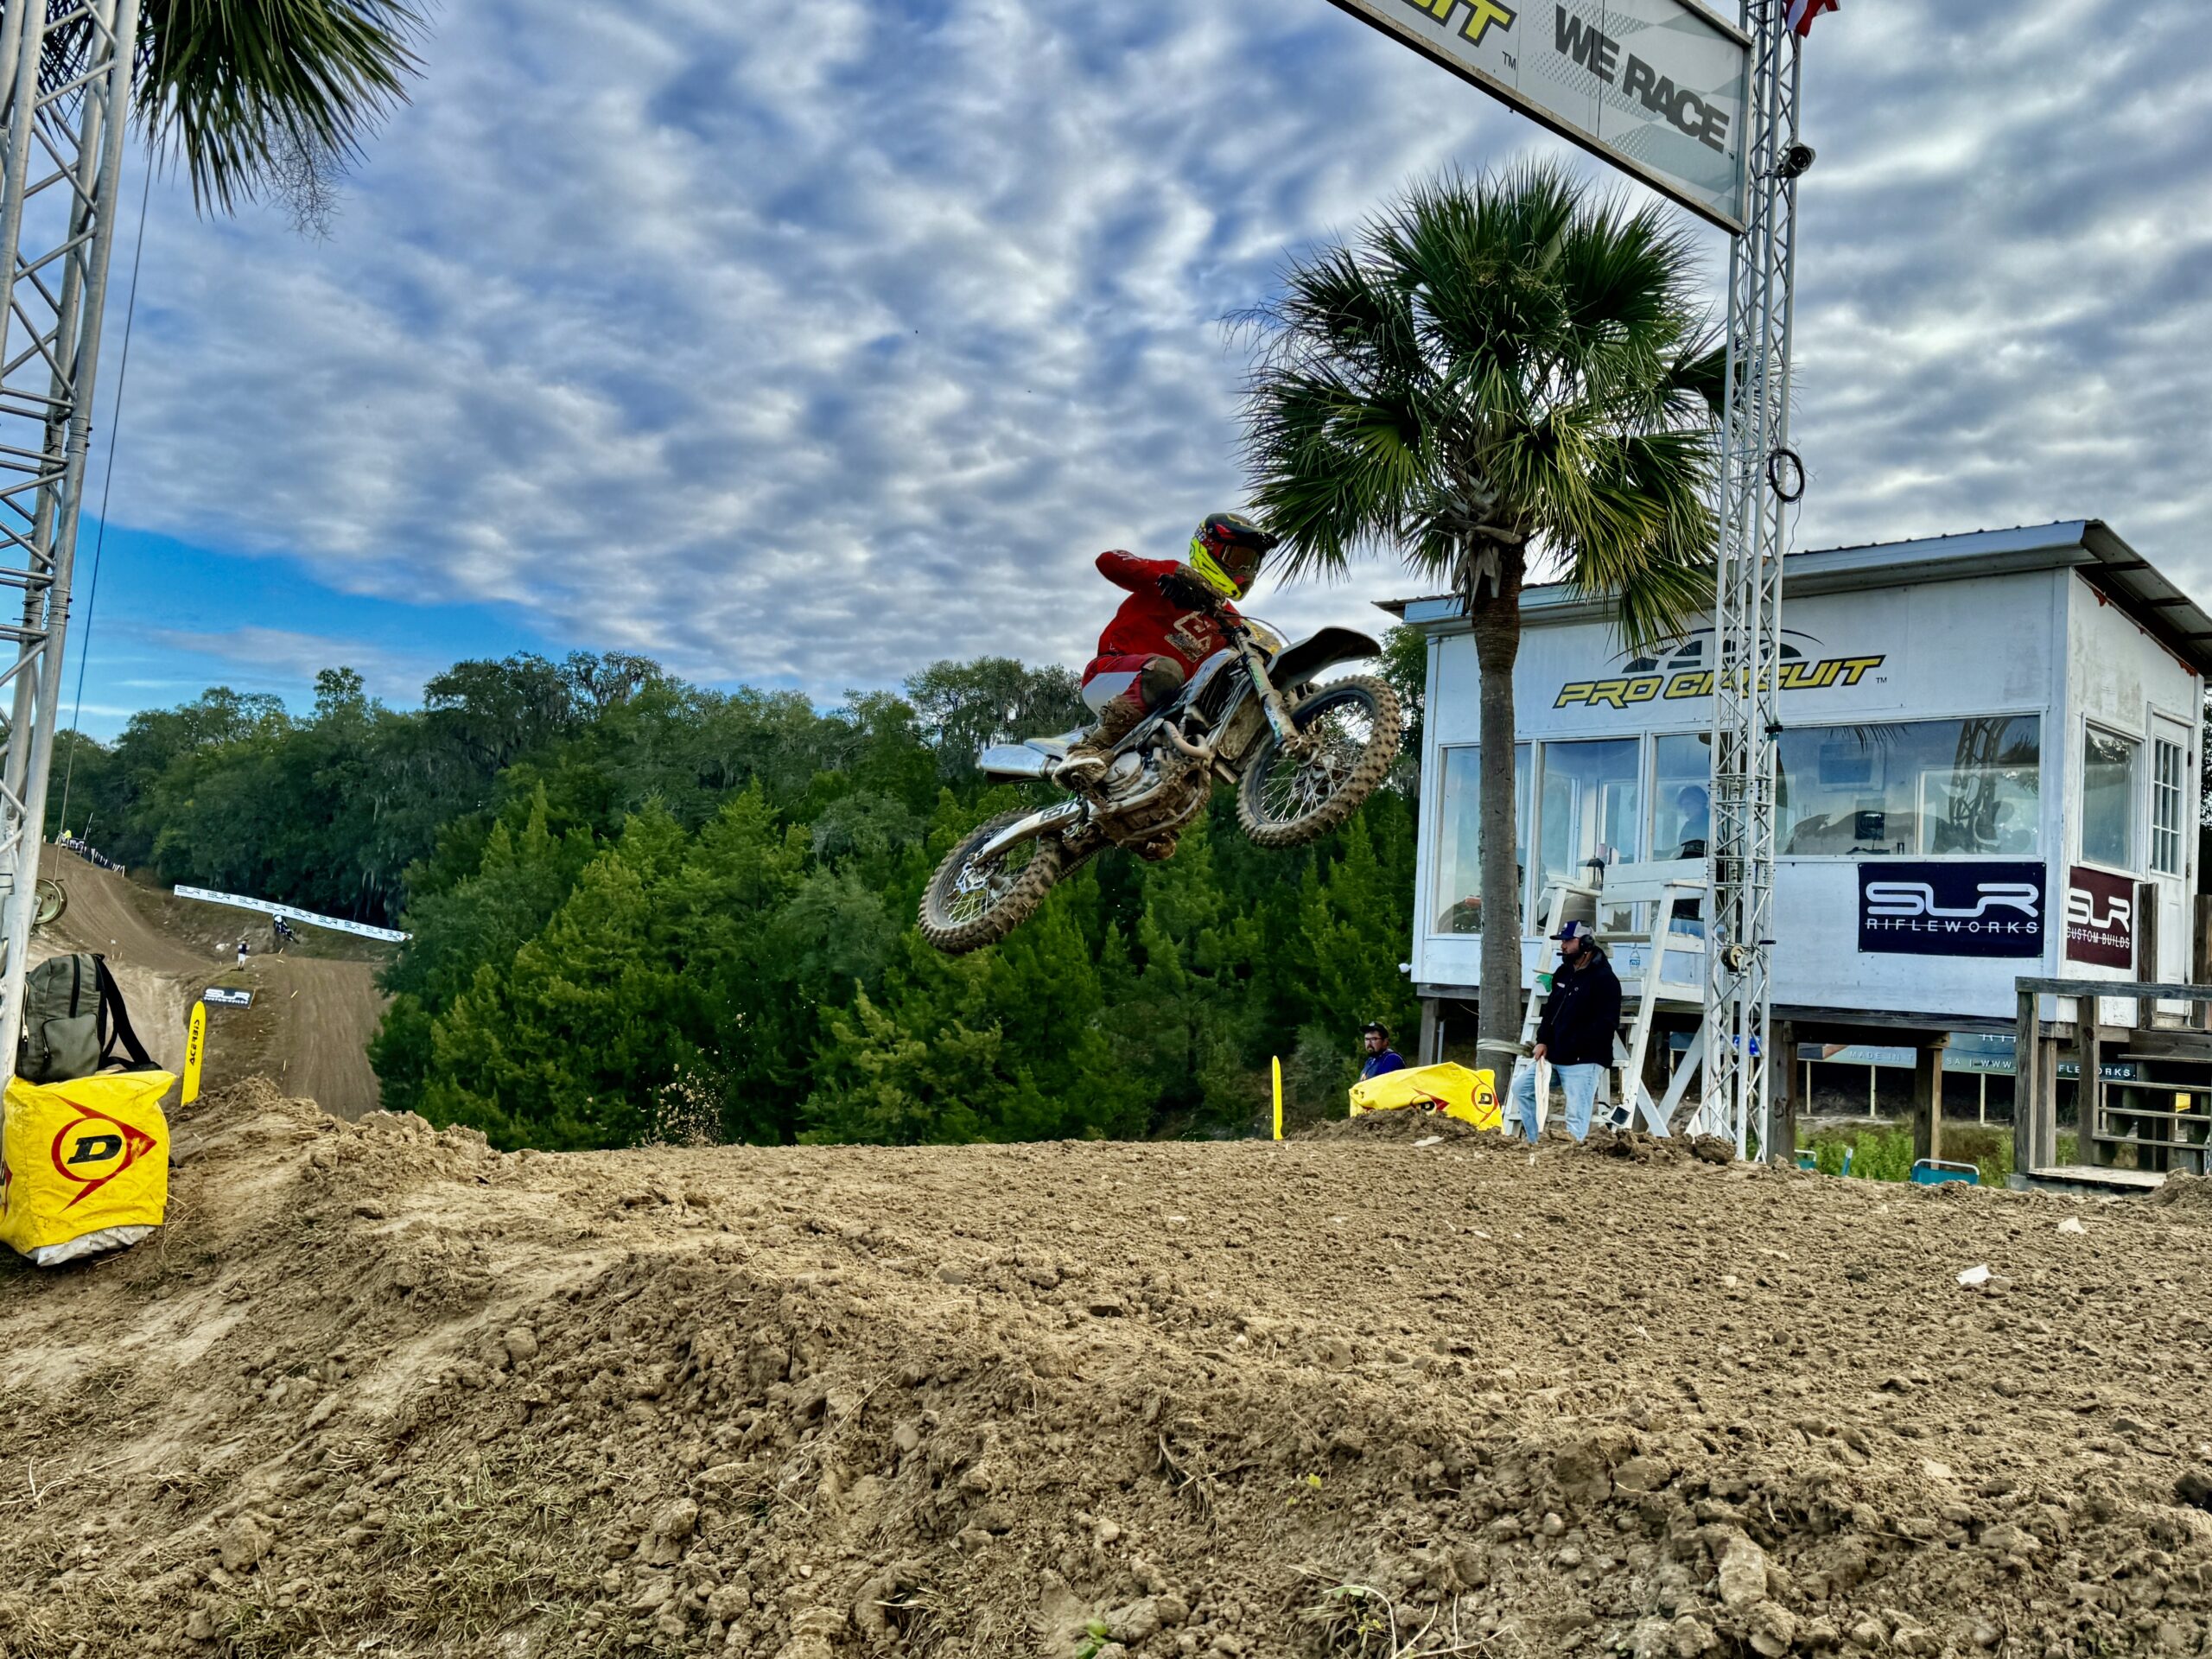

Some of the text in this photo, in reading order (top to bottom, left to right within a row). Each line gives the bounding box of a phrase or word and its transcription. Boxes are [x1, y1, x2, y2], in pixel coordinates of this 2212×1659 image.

[1402, 0, 1517, 48] IT
[1555, 4, 1620, 85] WE
[1623, 53, 1730, 154] RACE
[1552, 676, 1663, 709] PRO
[1866, 882, 2039, 917] SLR
[2068, 887, 2131, 932] SLR
[1866, 918, 2038, 934] RIFLEWORKS
[2068, 926, 2130, 949] CUSTOM BUILDS
[205, 988, 251, 1001] SLR
[1849, 1051, 1881, 1061] MADE
[1888, 1053, 1900, 1062] IN
[1478, 1092, 1493, 1105] D
[67, 1135, 123, 1165] D
